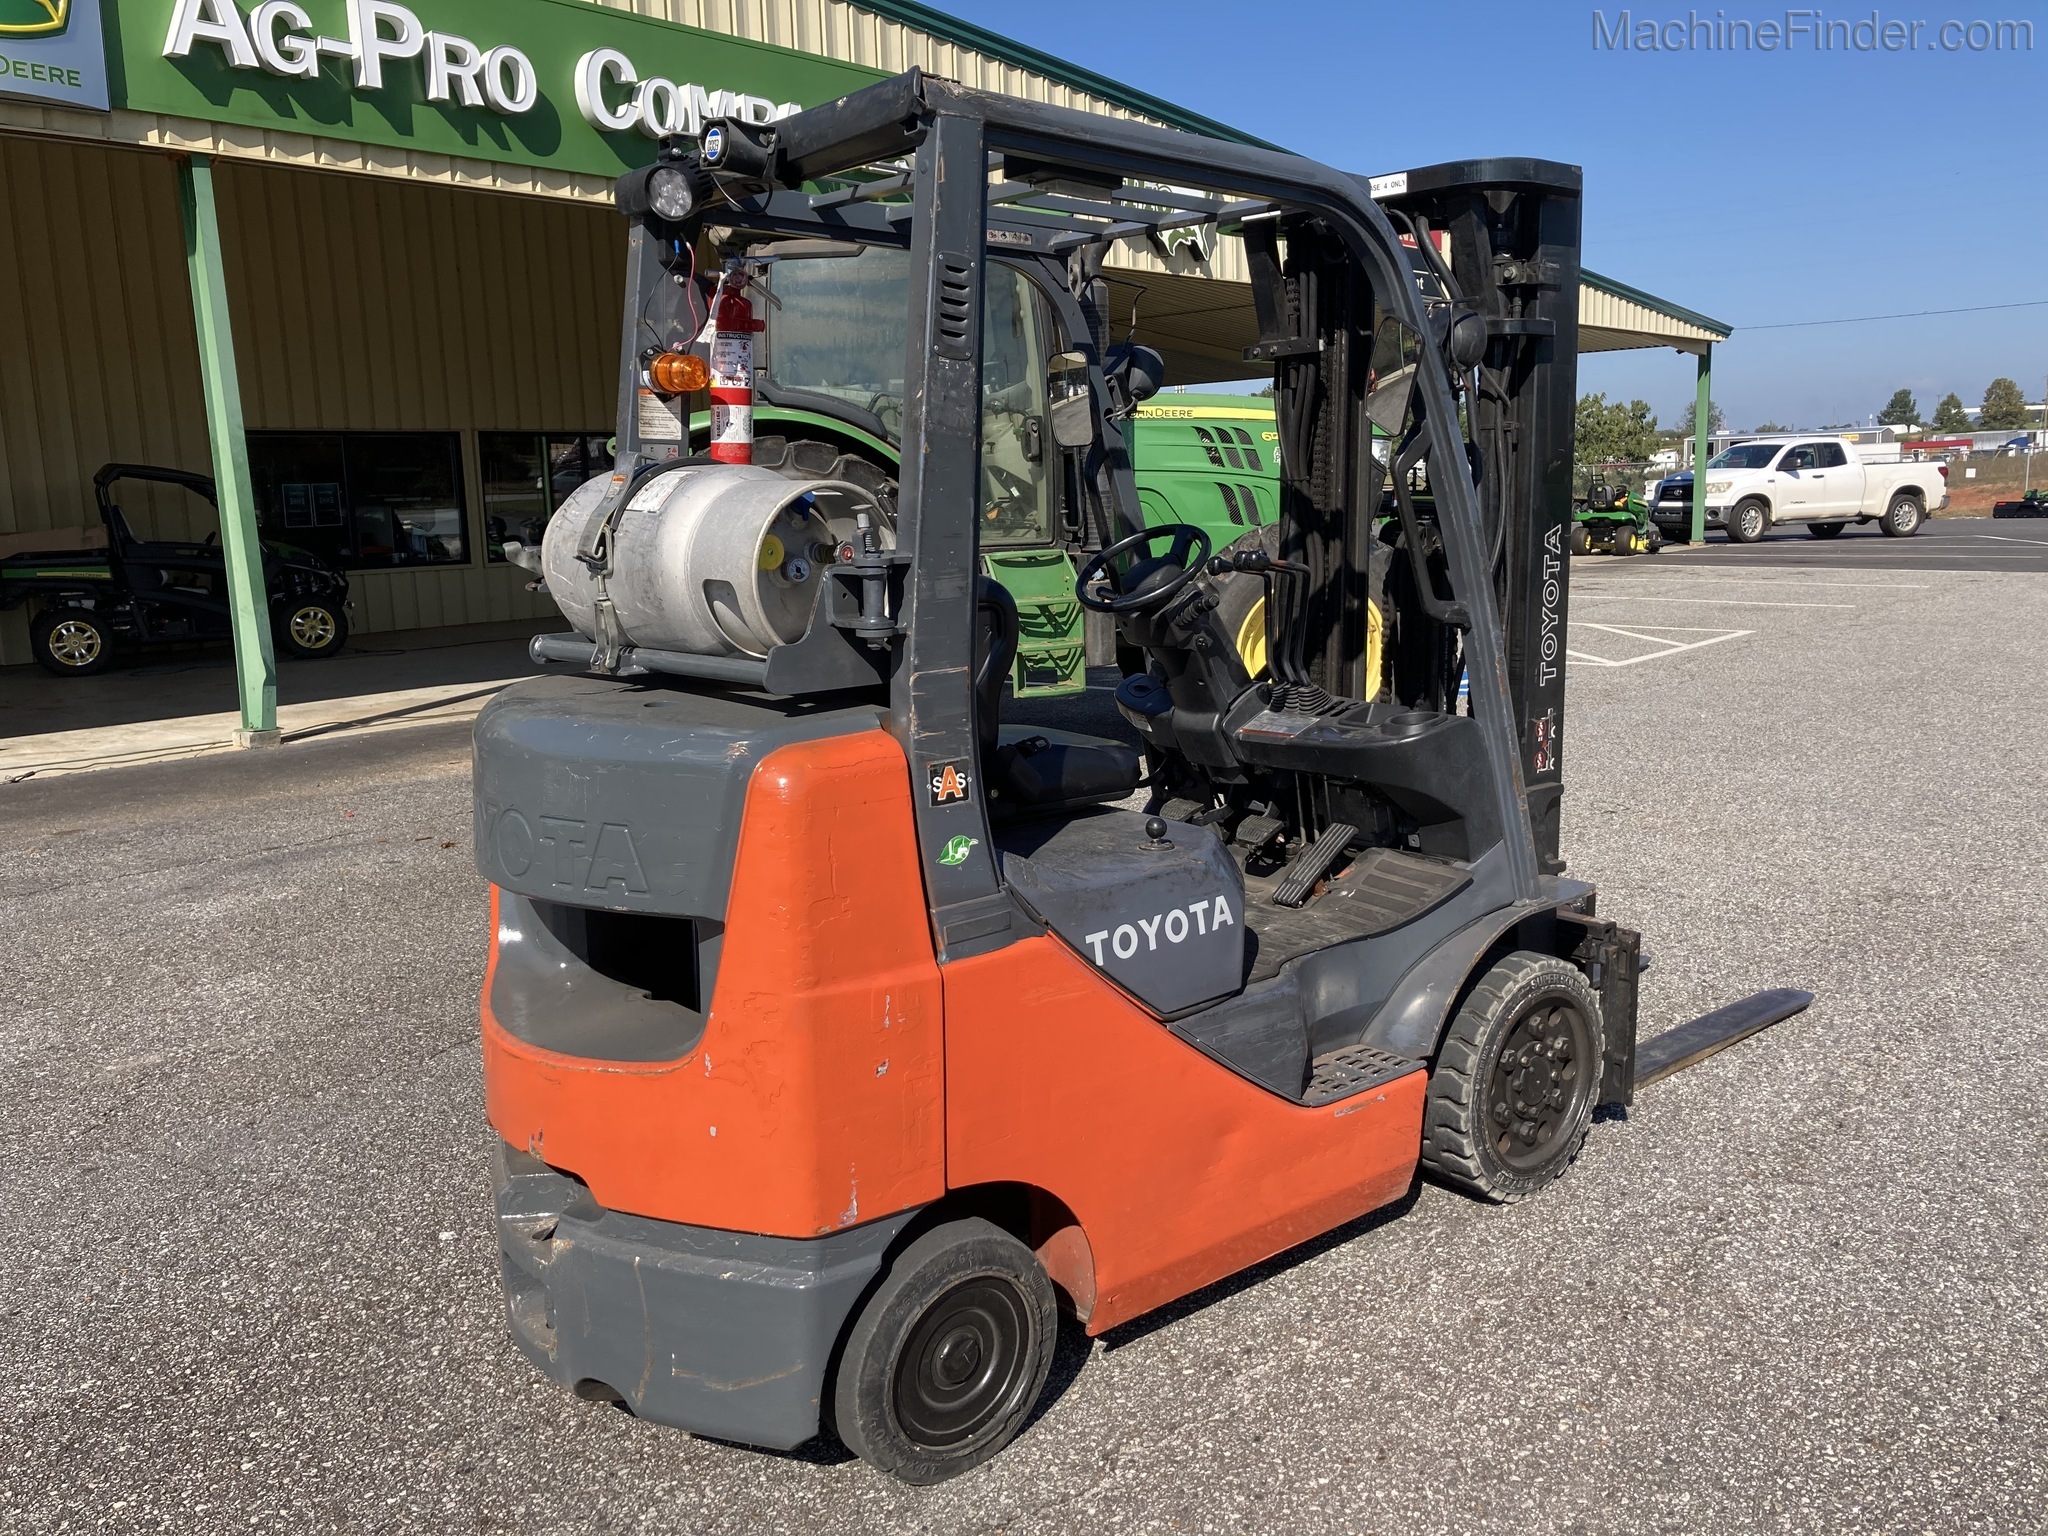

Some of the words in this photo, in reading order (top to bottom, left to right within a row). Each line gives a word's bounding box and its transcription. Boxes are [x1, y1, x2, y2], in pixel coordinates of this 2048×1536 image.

[1390, 180, 1405, 189] ONLY
[1155, 407, 1194, 418] DEERE
[1539, 523, 1562, 687] TOYOTA
[932, 765, 967, 801] SAS
[1085, 894, 1235, 967] TOYOTA
